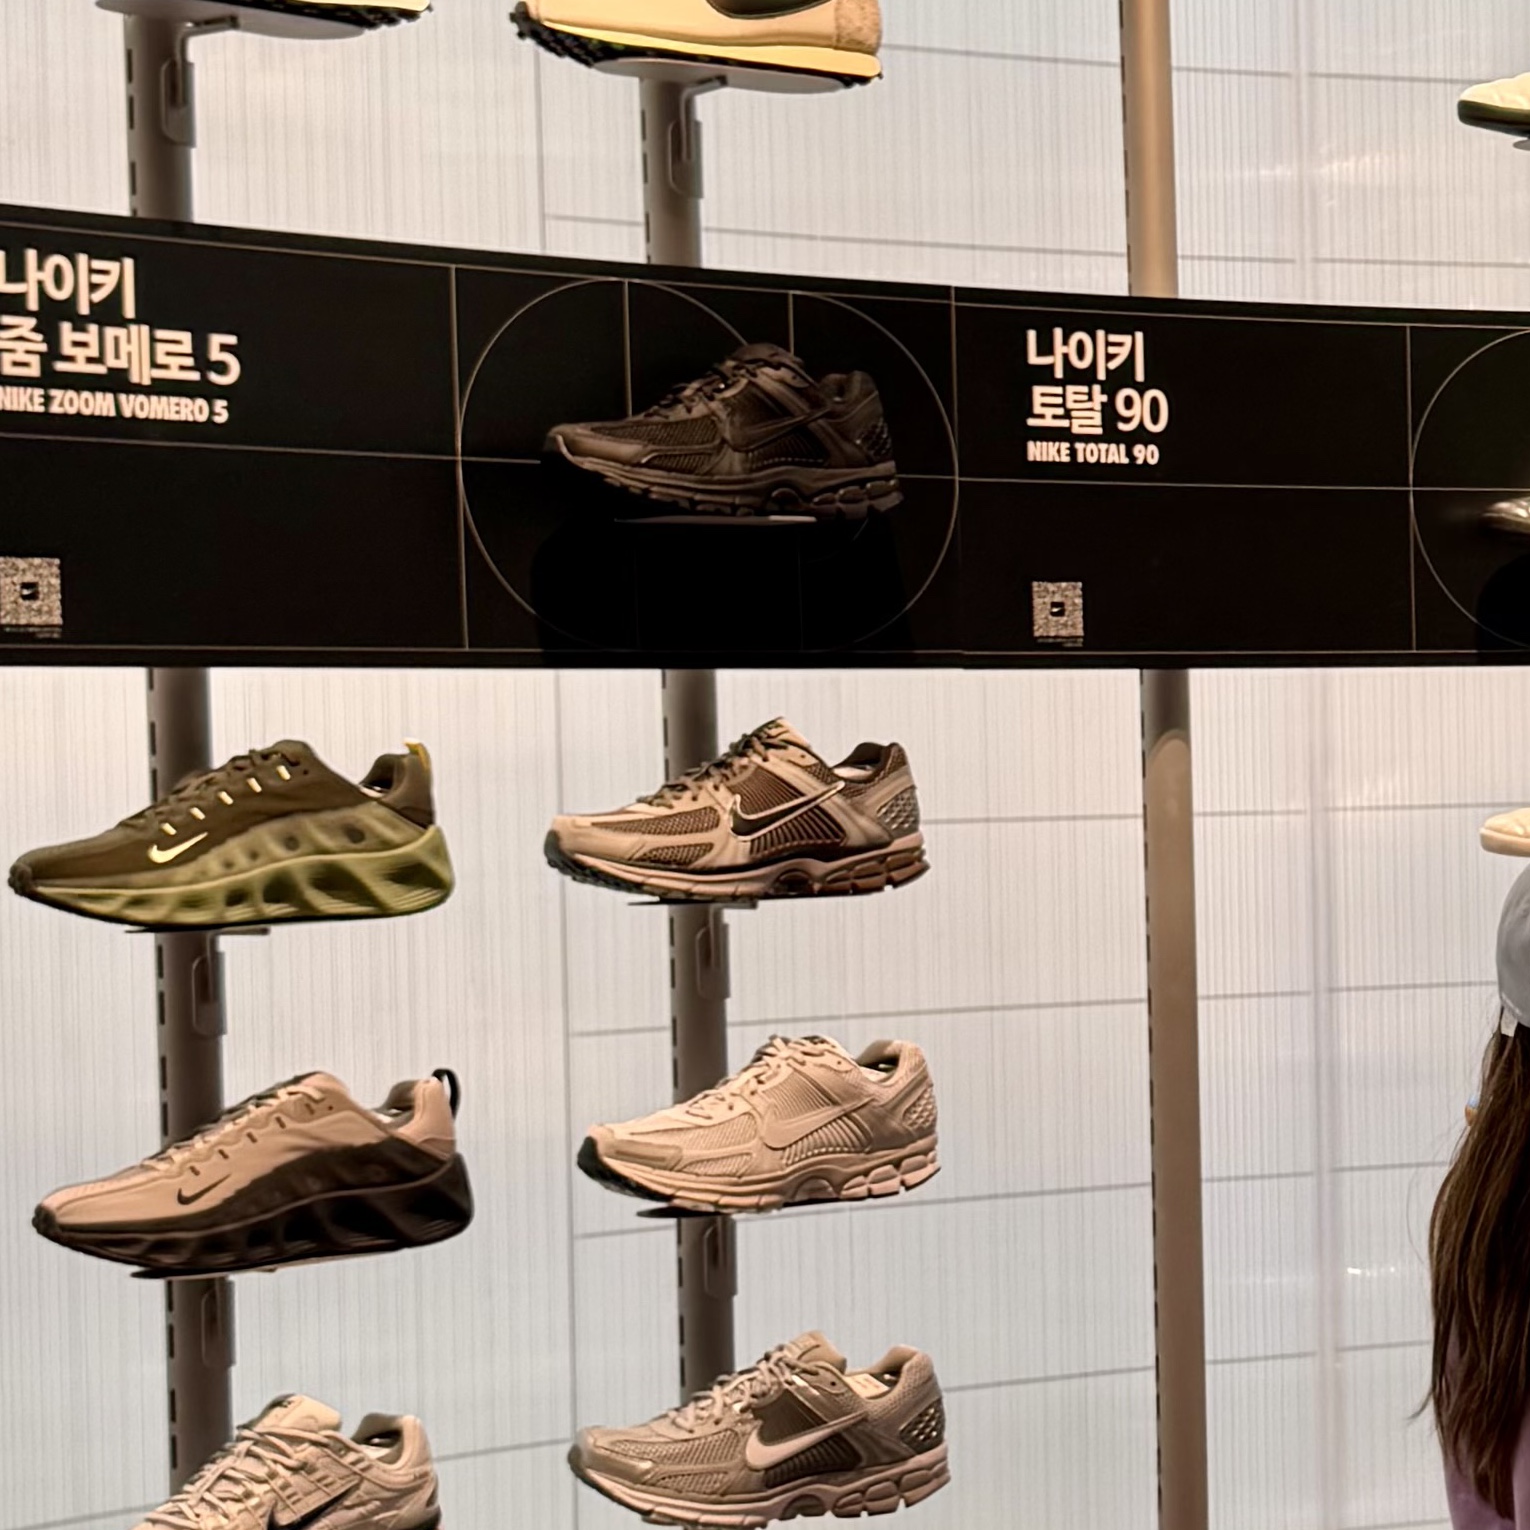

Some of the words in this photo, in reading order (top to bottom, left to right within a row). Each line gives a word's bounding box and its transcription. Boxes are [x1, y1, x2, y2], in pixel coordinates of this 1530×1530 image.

[0, 249, 136, 319] 나이키
[0, 315, 48, 378] 줌
[53, 320, 201, 386] 보메로
[207, 333, 241, 386] 5
[1026, 327, 1146, 383] 나이키
[0, 386, 46, 413] NIKE
[48, 389, 117, 417] ZOOM
[118, 393, 210, 423] VOMERO
[212, 398, 229, 424] 5
[1026, 383, 1108, 435] 토탈
[1115, 387, 1169, 433] 90
[1027, 440, 1071, 463] NIKE
[1074, 441, 1130, 465] TOTAL
[1132, 443, 1160, 466] 90
